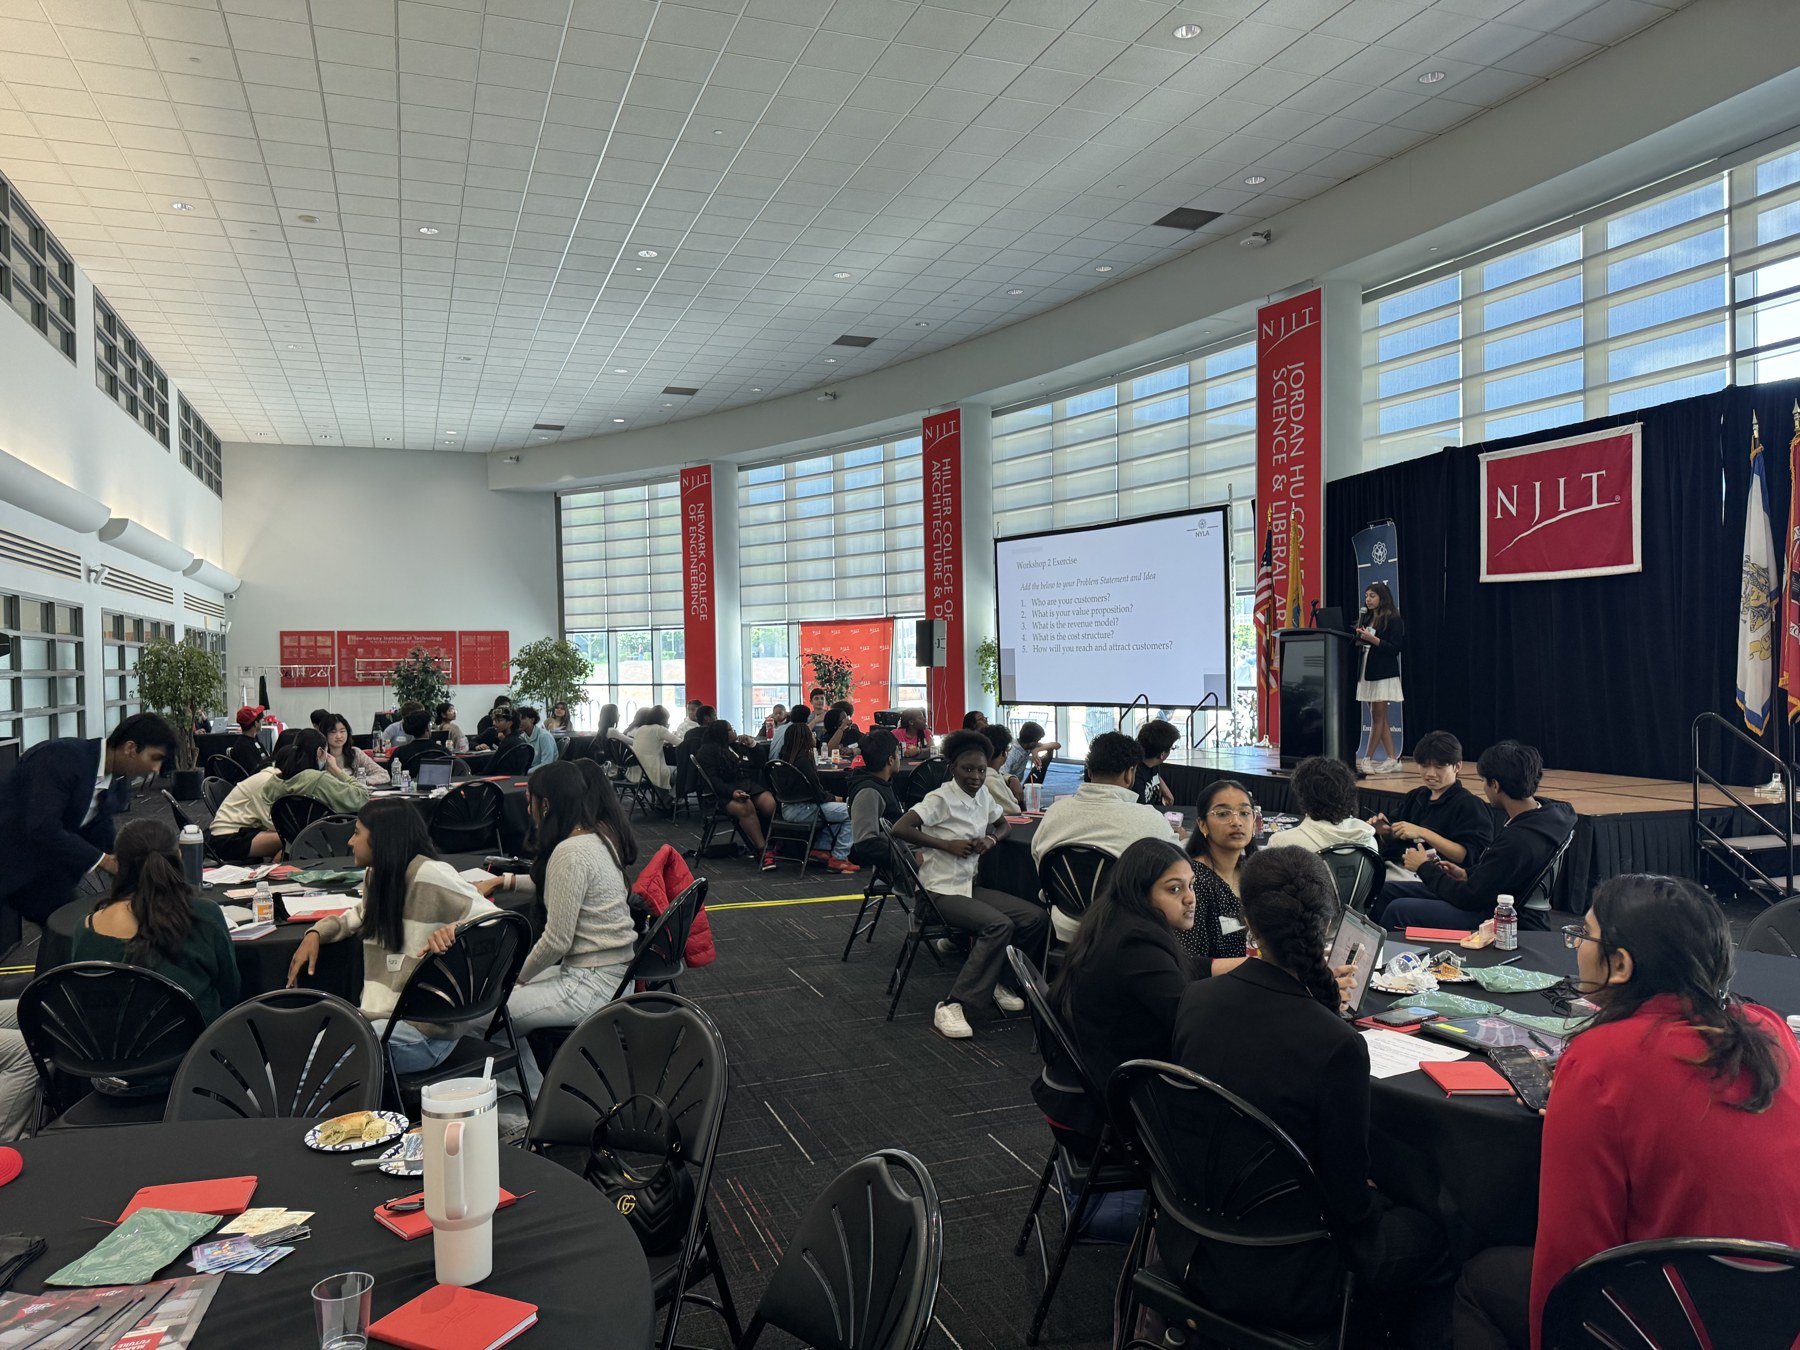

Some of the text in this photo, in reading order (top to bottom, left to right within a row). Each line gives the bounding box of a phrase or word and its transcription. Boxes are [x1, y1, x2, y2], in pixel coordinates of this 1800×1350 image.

[1262, 307, 1313, 339] NJIT
[1272, 367, 1287, 467] SCIENCE
[1287, 362, 1305, 457] JORDAN
[926, 420, 956, 440] NJIT
[682, 473, 708, 488] NJIT
[1272, 474, 1287, 493] &
[1289, 465, 1305, 499] HU
[1494, 470, 1606, 526] NJIT
[932, 460, 942, 580] ARCHITECTURE
[942, 458, 954, 621] HILLIER COLLEGE OF
[1272, 501, 1287, 586] LIBERAL
[689, 504, 699, 615] OF ENGINEERING
[697, 503, 707, 621] NEWARK COLLEGE
[1016, 556, 1077, 570] Workshop 2 Exercise
[933, 586, 942, 598] &
[1032, 598, 1046, 607] Who
[1057, 598, 1073, 607] your
[1073, 592, 1110, 603] customers?
[1021, 603, 1133, 620] 2. What is your value proposition?
[1032, 621, 1049, 629] What
[1050, 621, 1055, 629] is
[1056, 620, 1066, 629] the
[1067, 620, 1093, 629] revenue
[1094, 617, 1119, 627] model?
[1032, 633, 1049, 641] What
[1050, 633, 1056, 641] is
[1056, 632, 1067, 641] the
[1067, 632, 1080, 641] cost
[1081, 629, 1115, 640] structure?
[1032, 644, 1047, 653] How
[1048, 644, 1061, 653] will
[1062, 645, 1075, 655] you
[1075, 643, 1093, 652] reach
[1094, 643, 1107, 652] and
[1108, 642, 1131, 651] attract
[1132, 640, 1173, 651] customers?
